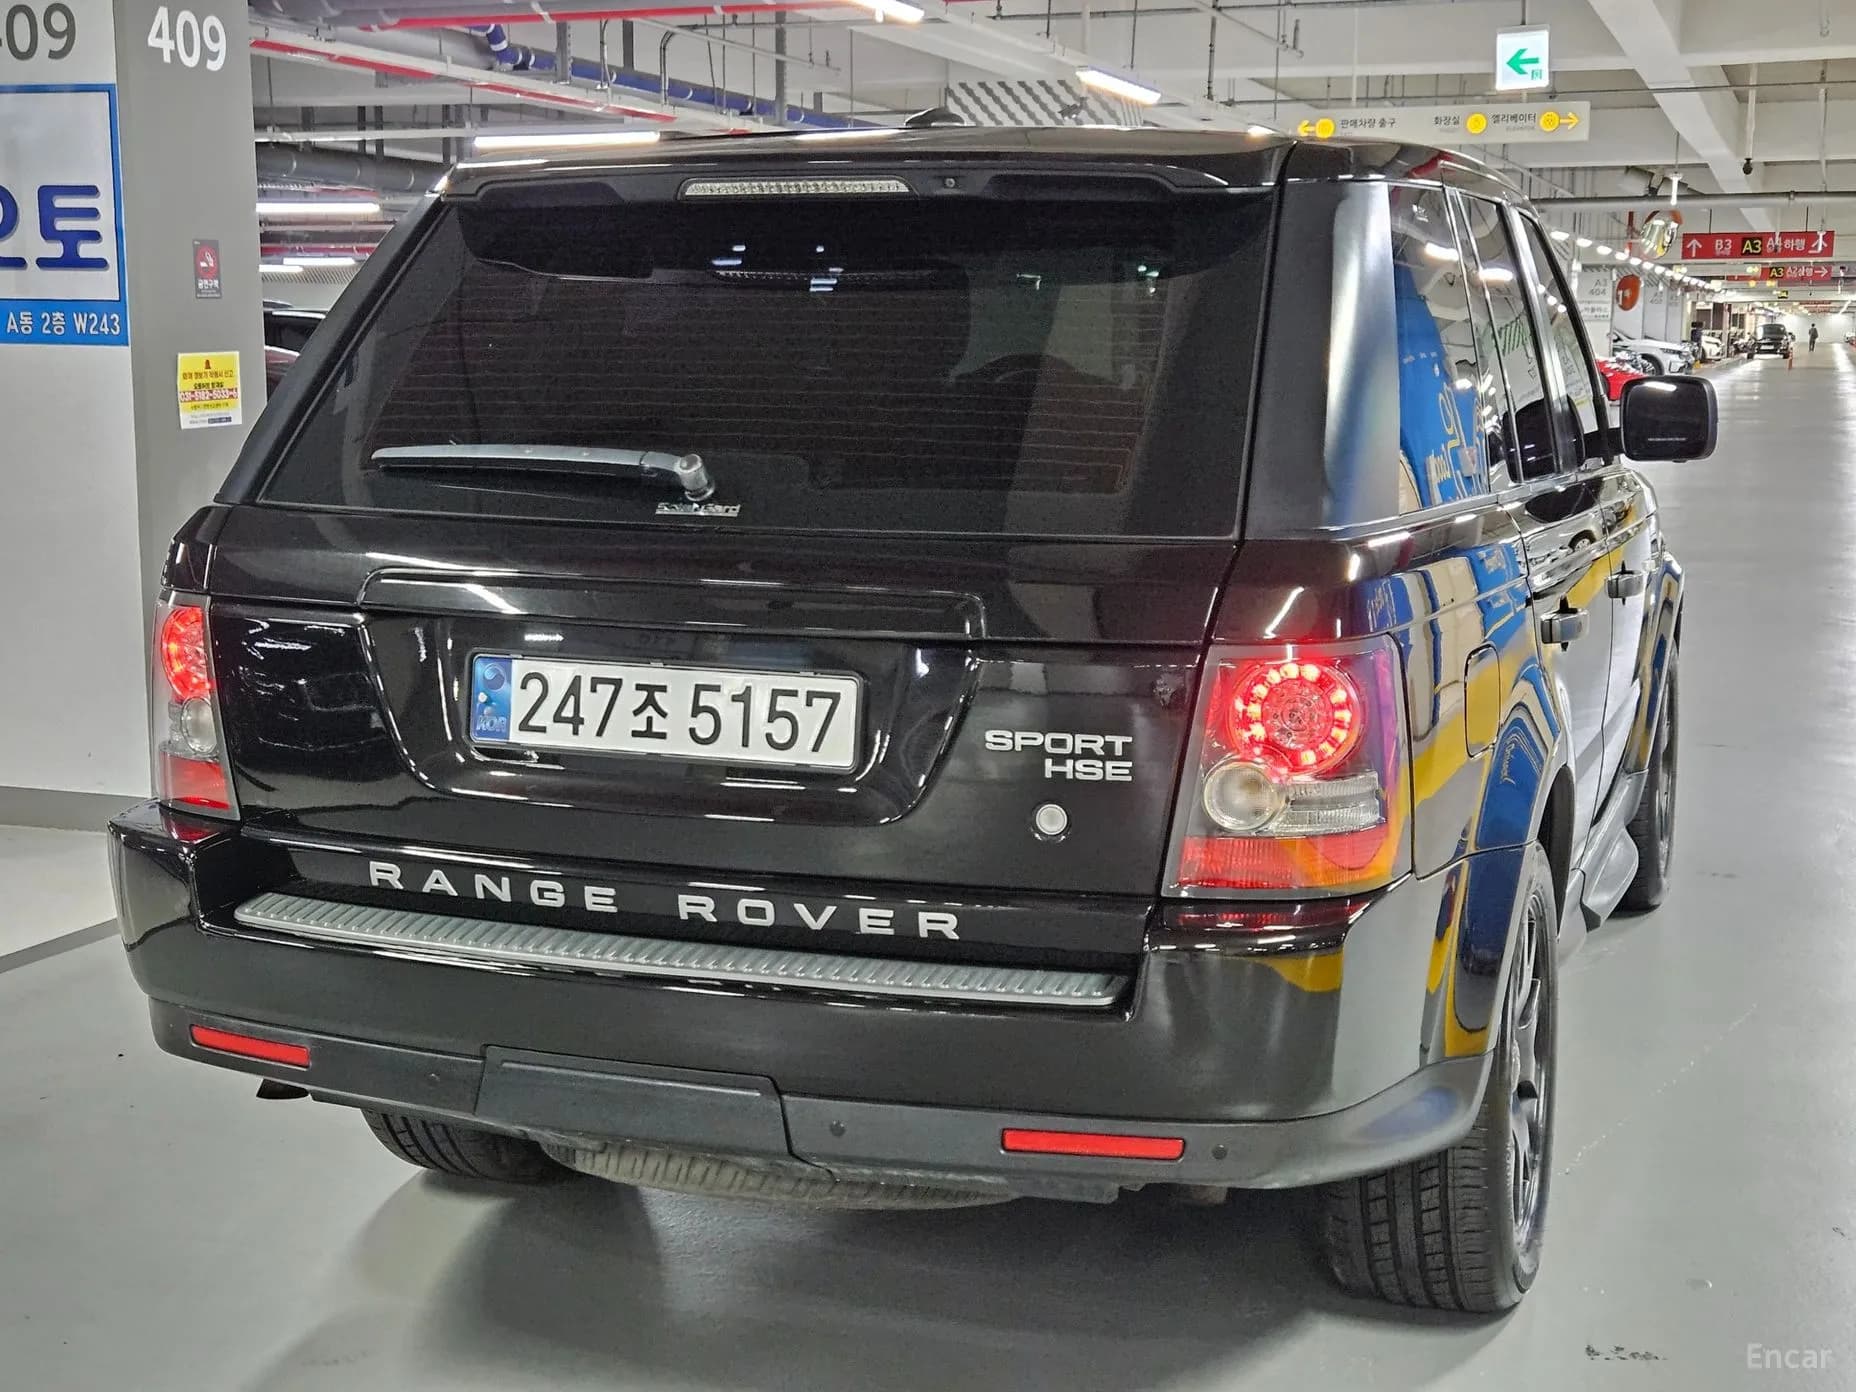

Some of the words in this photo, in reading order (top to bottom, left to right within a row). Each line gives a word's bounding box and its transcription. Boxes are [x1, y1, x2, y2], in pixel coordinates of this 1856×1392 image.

[0, 3, 76, 60] 09
[147, 6, 226, 71] 409
[1434, 115, 1460, 126] 화장실
[1715, 239, 1732, 250] B3
[1742, 239, 1762, 253] A3
[1769, 267, 1784, 277] A3
[7, 311, 33, 334] A동
[41, 311, 65, 335] 2층
[73, 312, 120, 335] W243
[518, 671, 668, 740] 247조
[688, 683, 842, 753] 5157
[985, 730, 1133, 756] SPORT
[1044, 758, 1133, 781] HSE
[368, 860, 618, 913] RANGE
[677, 893, 960, 940] ROVER
